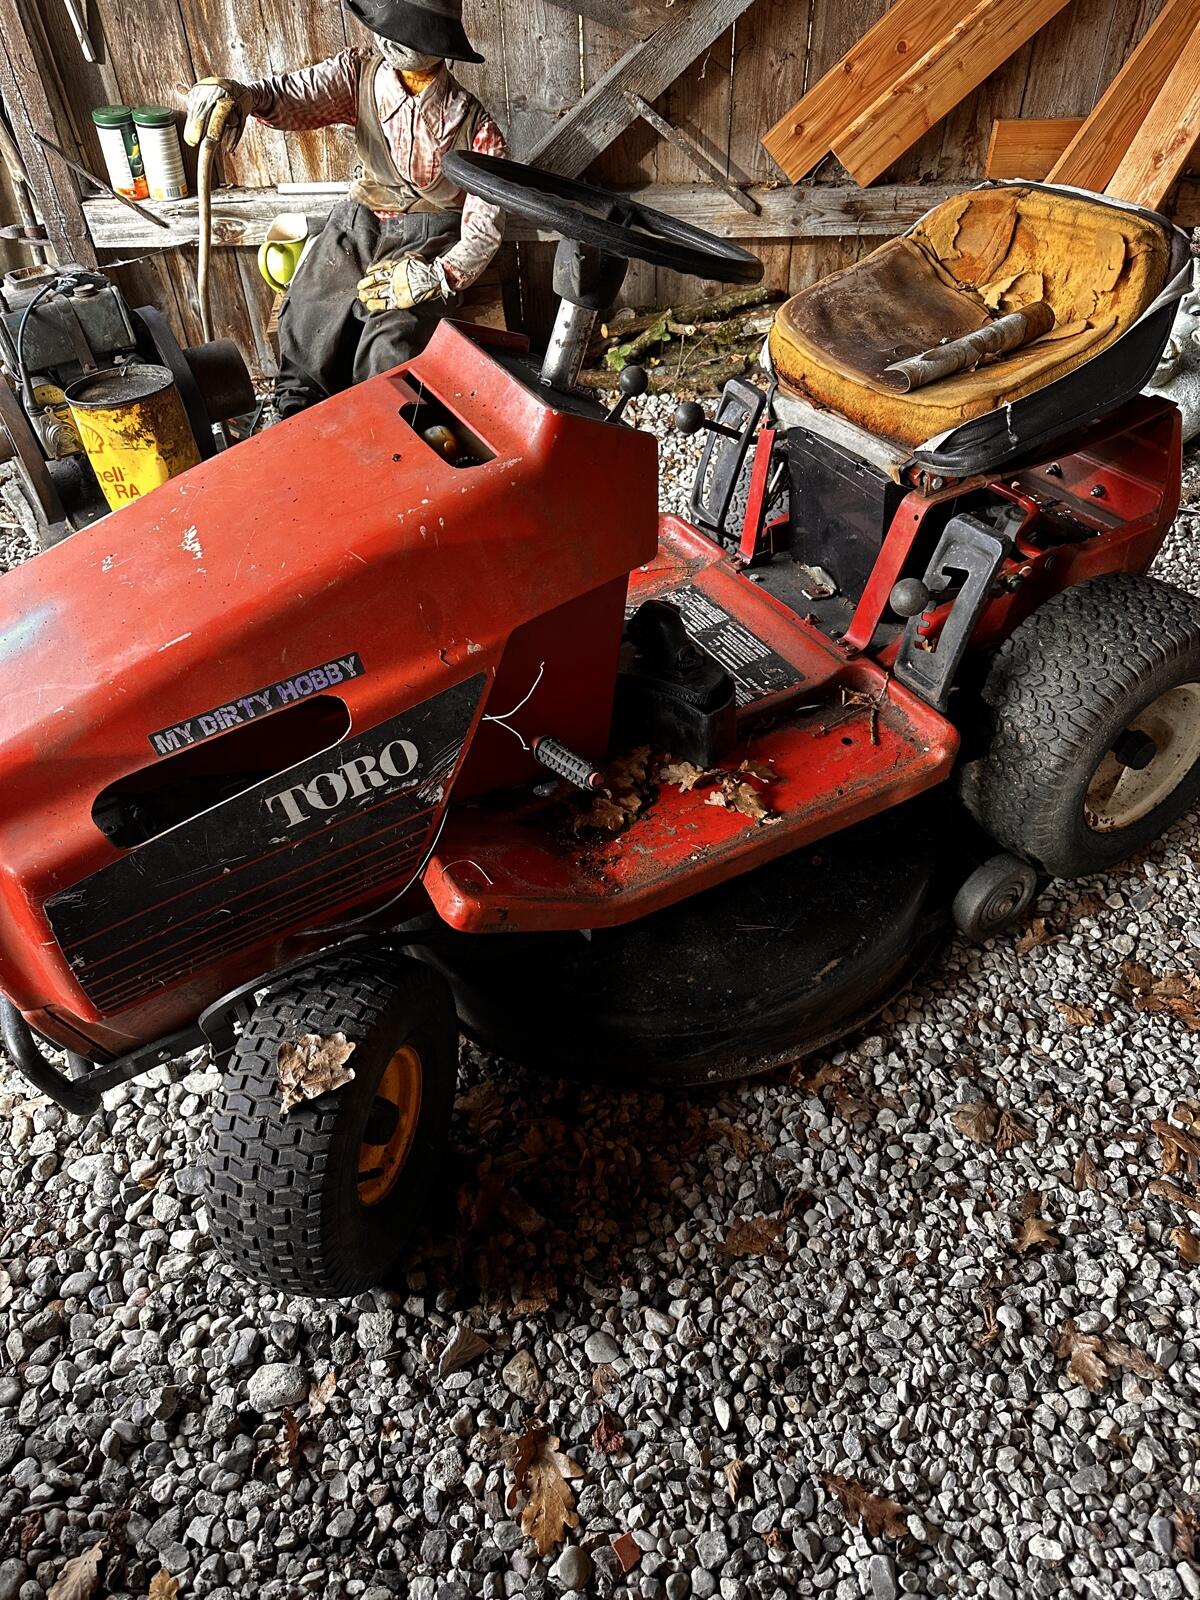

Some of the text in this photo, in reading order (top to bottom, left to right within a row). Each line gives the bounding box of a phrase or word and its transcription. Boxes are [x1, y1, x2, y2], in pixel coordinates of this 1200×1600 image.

[113, 483, 142, 499] RA
[154, 655, 357, 754] MY DIRTY HOBBY
[265, 739, 419, 828] TORO
